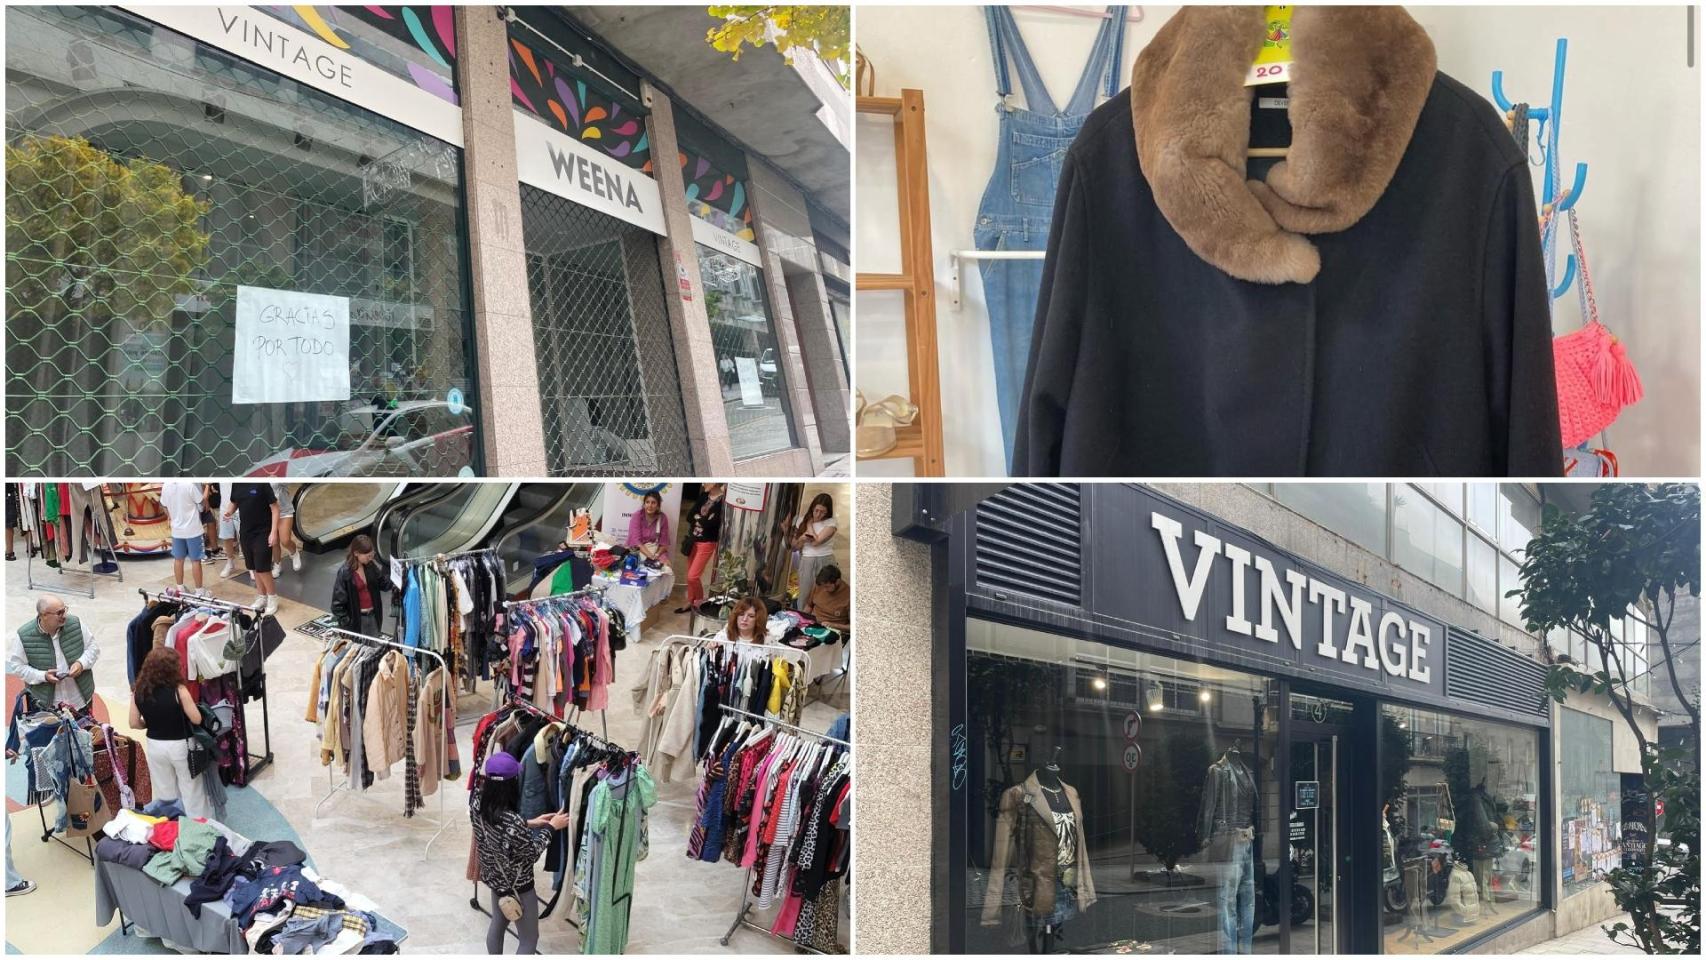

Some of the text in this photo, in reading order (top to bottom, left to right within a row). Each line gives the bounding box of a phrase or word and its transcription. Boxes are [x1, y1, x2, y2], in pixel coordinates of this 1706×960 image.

[218, 8, 352, 88] VINTAGE
[1256, 65, 1282, 78] 20
[545, 140, 643, 214] WEENA
[713, 231, 741, 253] VINTAGE
[255, 335, 334, 359] POR TODO
[1152, 511, 1430, 684] VINTAGE
[1314, 703, 1323, 720] 4
